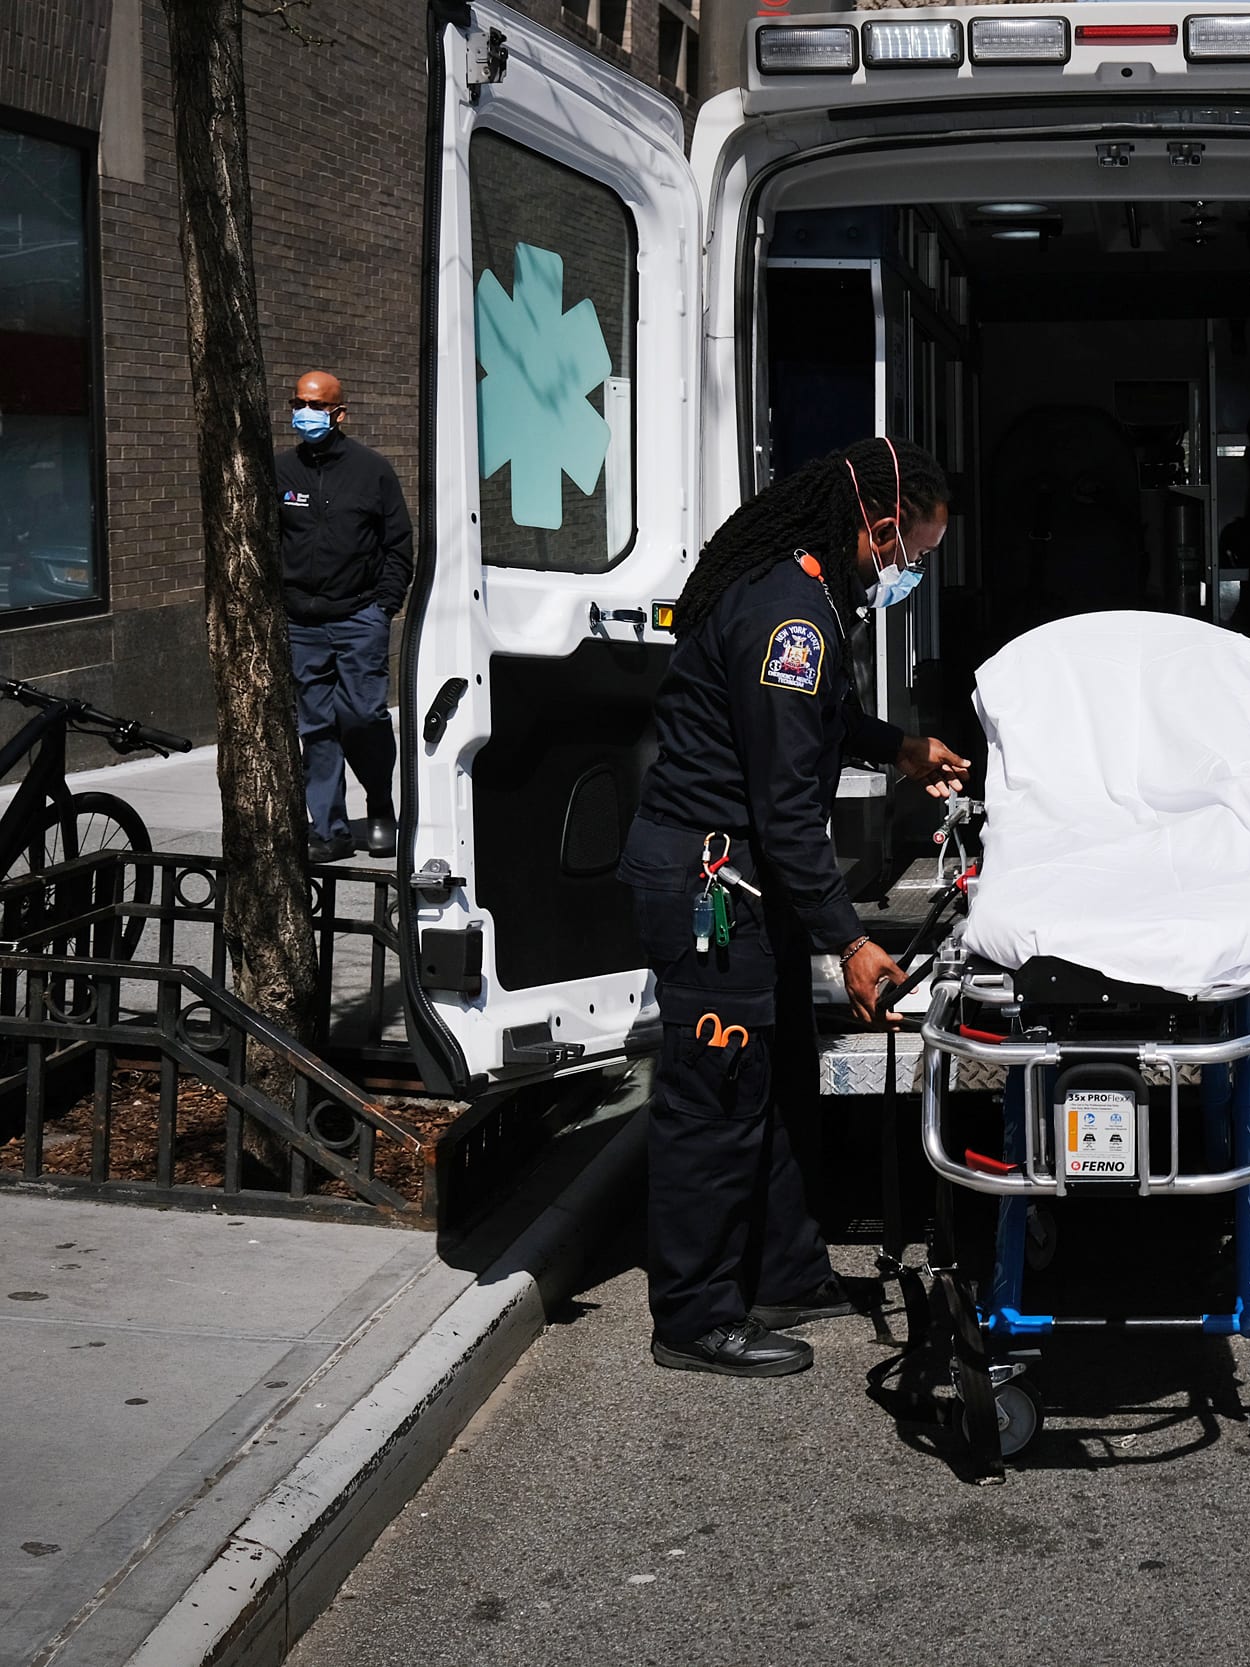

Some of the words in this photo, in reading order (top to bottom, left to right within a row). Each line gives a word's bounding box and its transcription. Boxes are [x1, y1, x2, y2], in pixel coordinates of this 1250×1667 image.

[775, 629, 789, 643] NEW
[789, 626, 807, 635] YORK
[807, 632, 820, 650] STATE
[1081, 1161, 1125, 1172] FERNO
